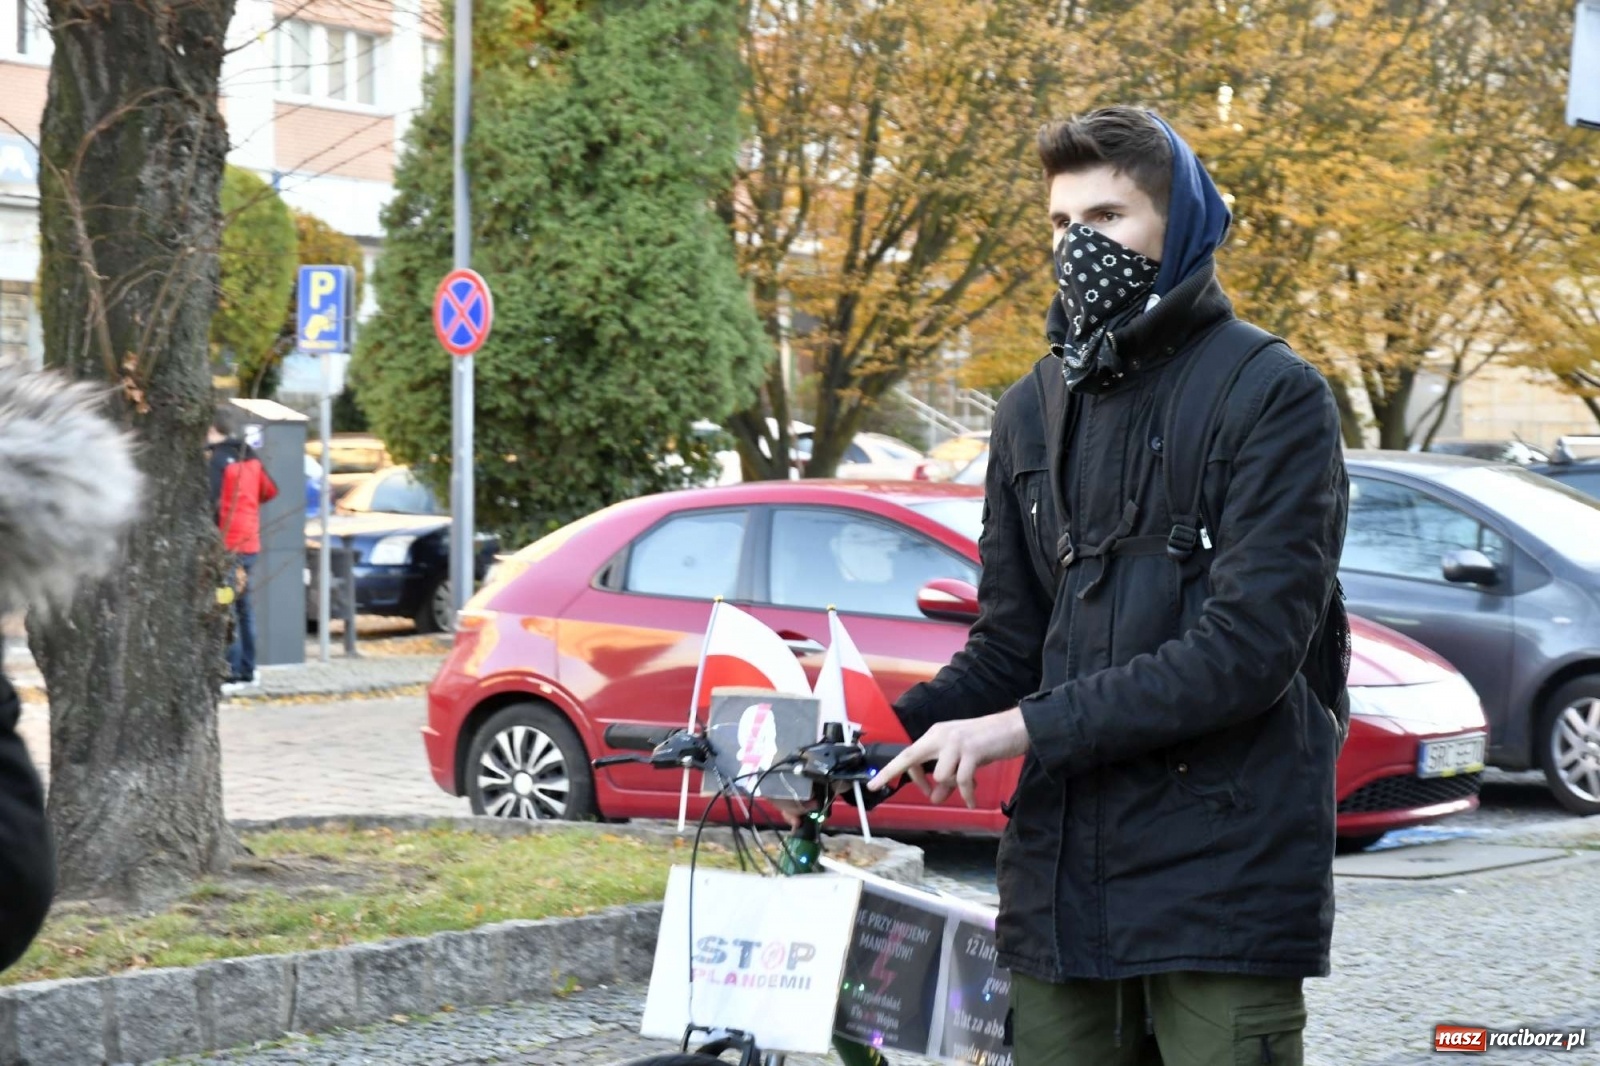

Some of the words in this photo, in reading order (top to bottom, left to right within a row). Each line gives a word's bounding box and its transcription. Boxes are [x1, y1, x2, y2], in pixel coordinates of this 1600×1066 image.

[309, 270, 337, 310] P
[692, 935, 816, 971] STOP
[965, 937, 979, 956] 12
[692, 967, 811, 990] PLANDEMII
[971, 1017, 984, 1034] za
[984, 1018, 1005, 1040] abo
